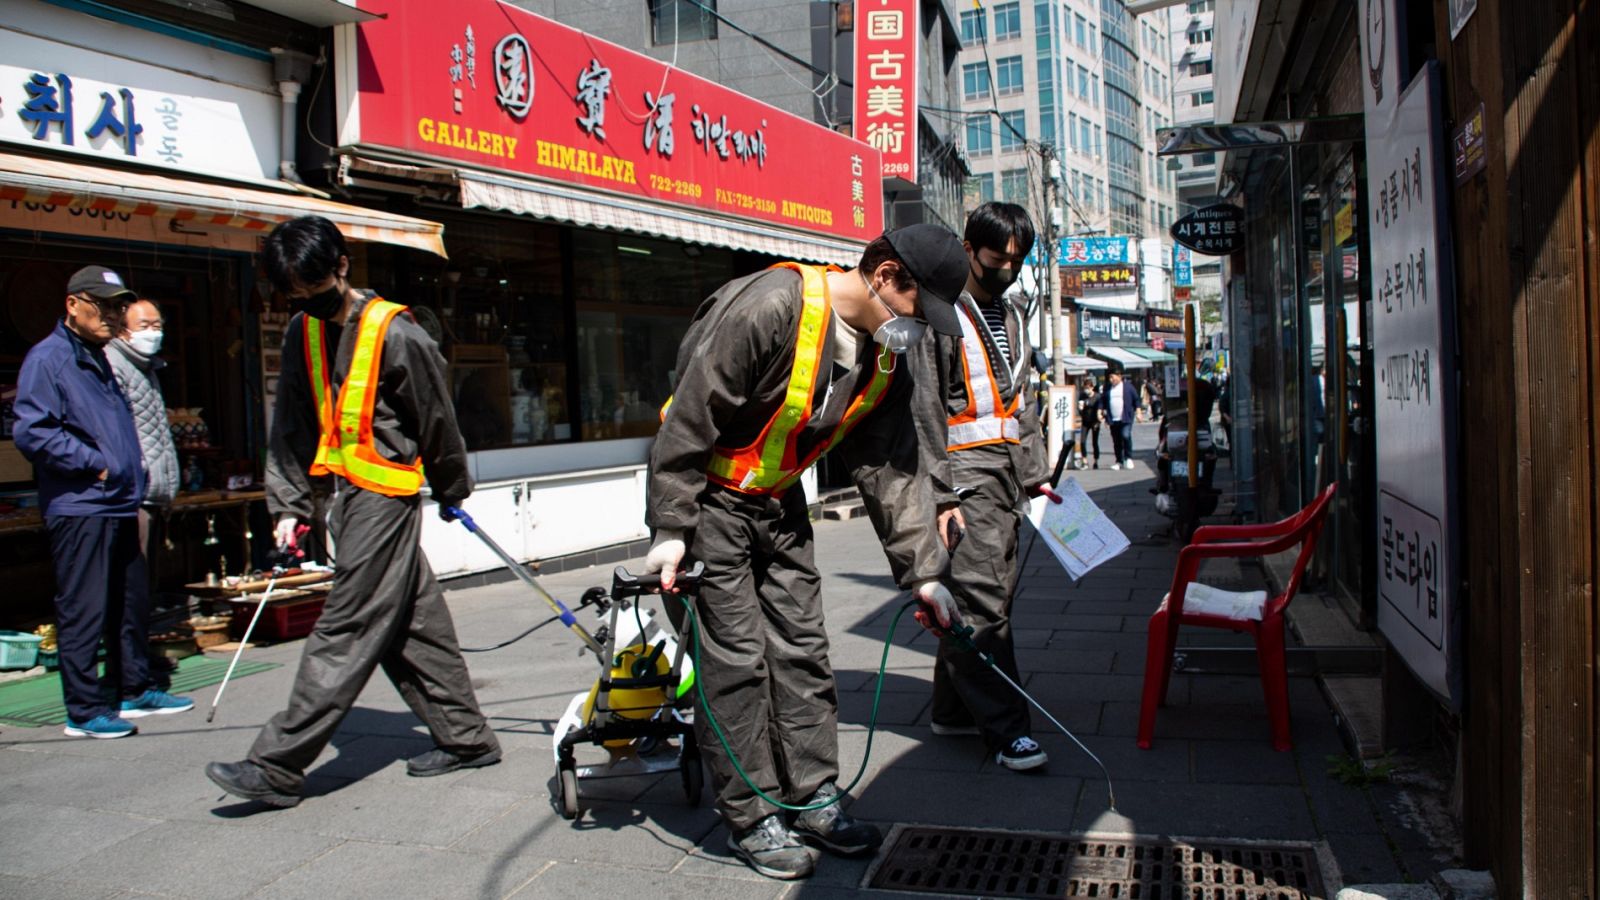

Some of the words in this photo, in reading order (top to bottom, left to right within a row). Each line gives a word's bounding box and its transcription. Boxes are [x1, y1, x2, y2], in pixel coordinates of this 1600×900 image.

[866, 0, 905, 154] 国古美術
[418, 117, 518, 159] GALLERY
[536, 139, 637, 185] HIMALAYA
[650, 173, 703, 199] 722-2269
[715, 187, 777, 214] FAX:725-3150
[781, 199, 833, 226] ANTIQUES
[850, 153, 866, 229] 古美術
[1192, 208, 1233, 219] Antiques
[1064, 240, 1091, 263] 꽃
[1381, 247, 1428, 314] 손목시계
[1383, 515, 1438, 620] 골드타임
